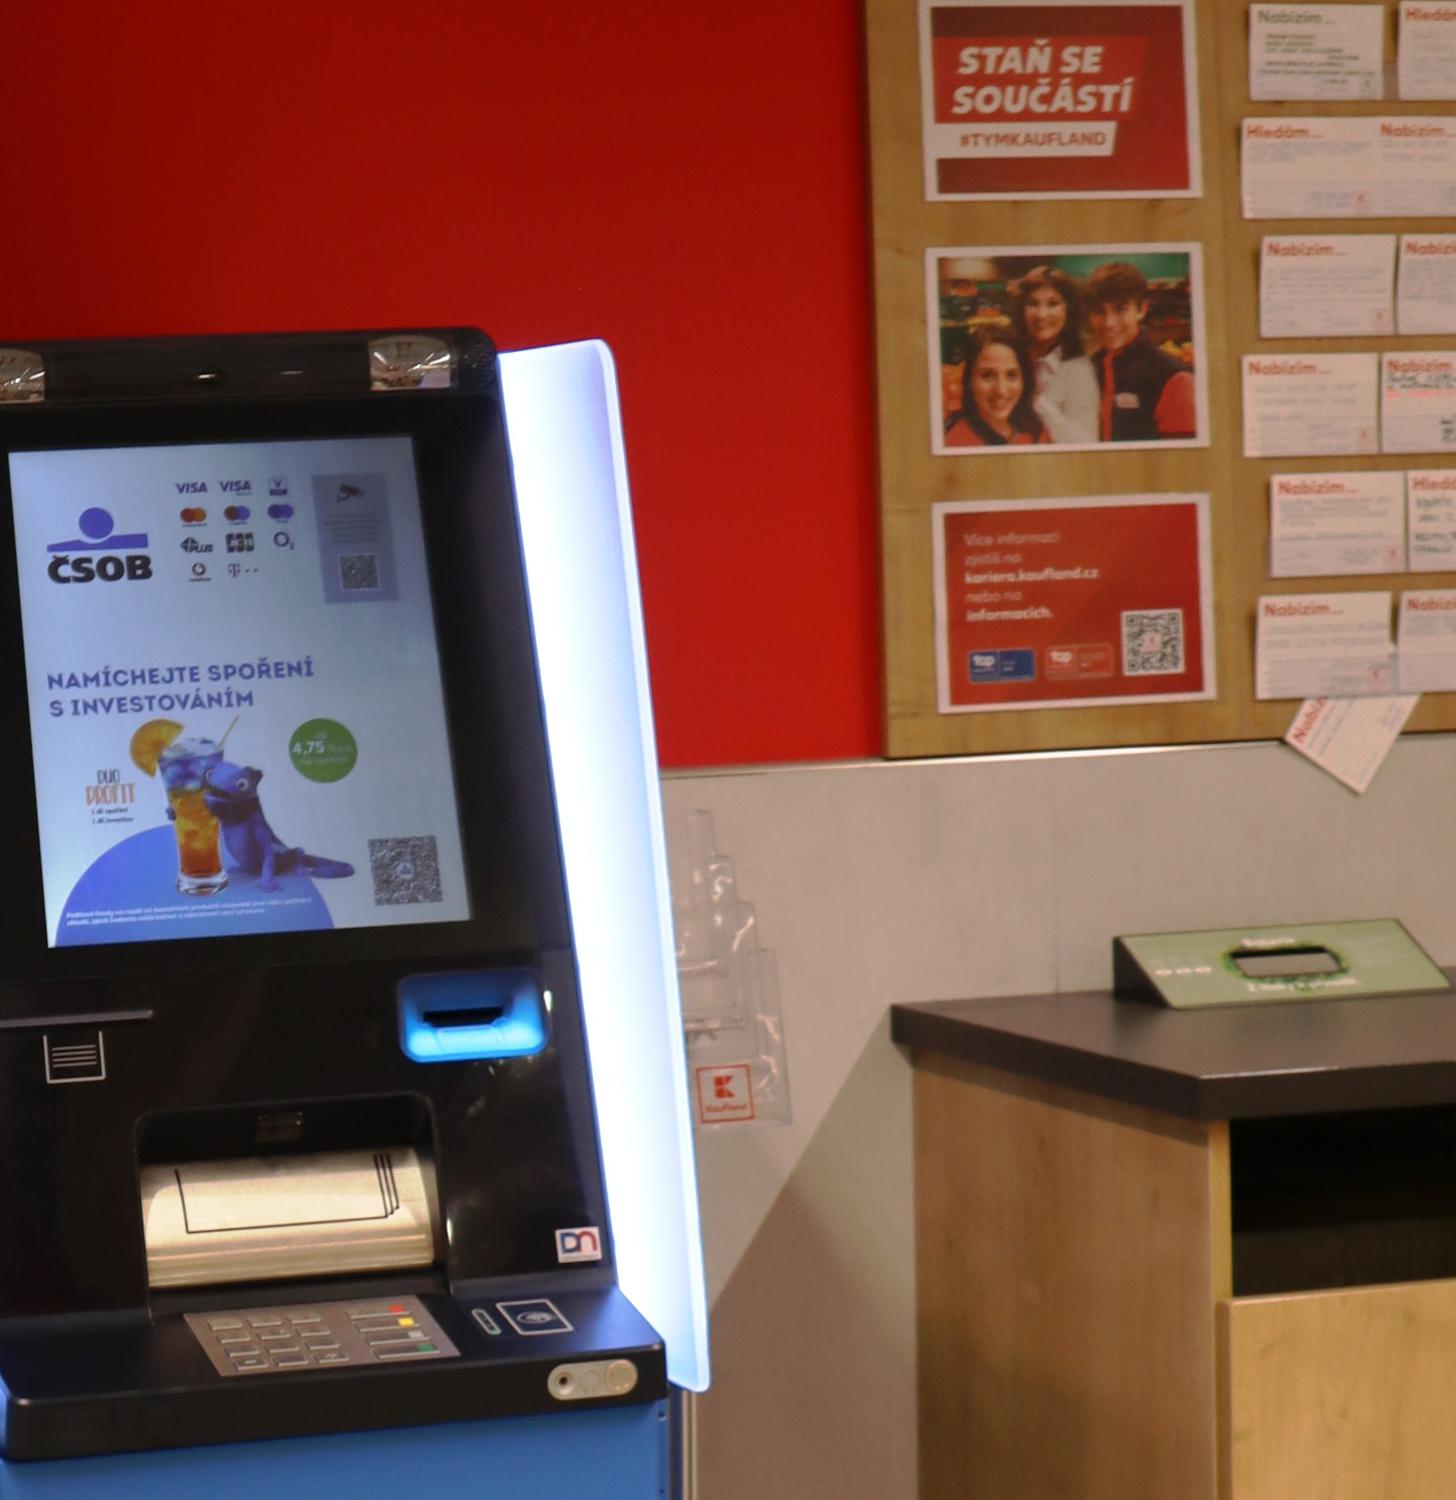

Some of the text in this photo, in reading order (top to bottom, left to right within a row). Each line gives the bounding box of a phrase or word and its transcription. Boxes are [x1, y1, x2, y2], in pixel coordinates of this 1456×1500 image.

[1407, 6, 1456, 21] Hledá
[957, 38, 1105, 75] STAŇ SE
[951, 77, 1135, 115] SOUČÁSTÍ
[960, 131, 1106, 147] #TYMKAUFLAND
[176, 482, 208, 494] VISA
[219, 480, 252, 493] VISA
[963, 533, 993, 546] Více
[1003, 553, 1022, 565] na
[47, 554, 153, 584] ČSOB
[964, 566, 1100, 584] kariera.kaufland.cz
[966, 590, 1023, 603] nebo na
[47, 654, 315, 691] NAMÍCHEJTE SPOŘENÍ
[50, 687, 254, 717] S INVESTOVÁNÍM
[97, 768, 121, 784] DUO
[85, 783, 135, 806] PROFIT
